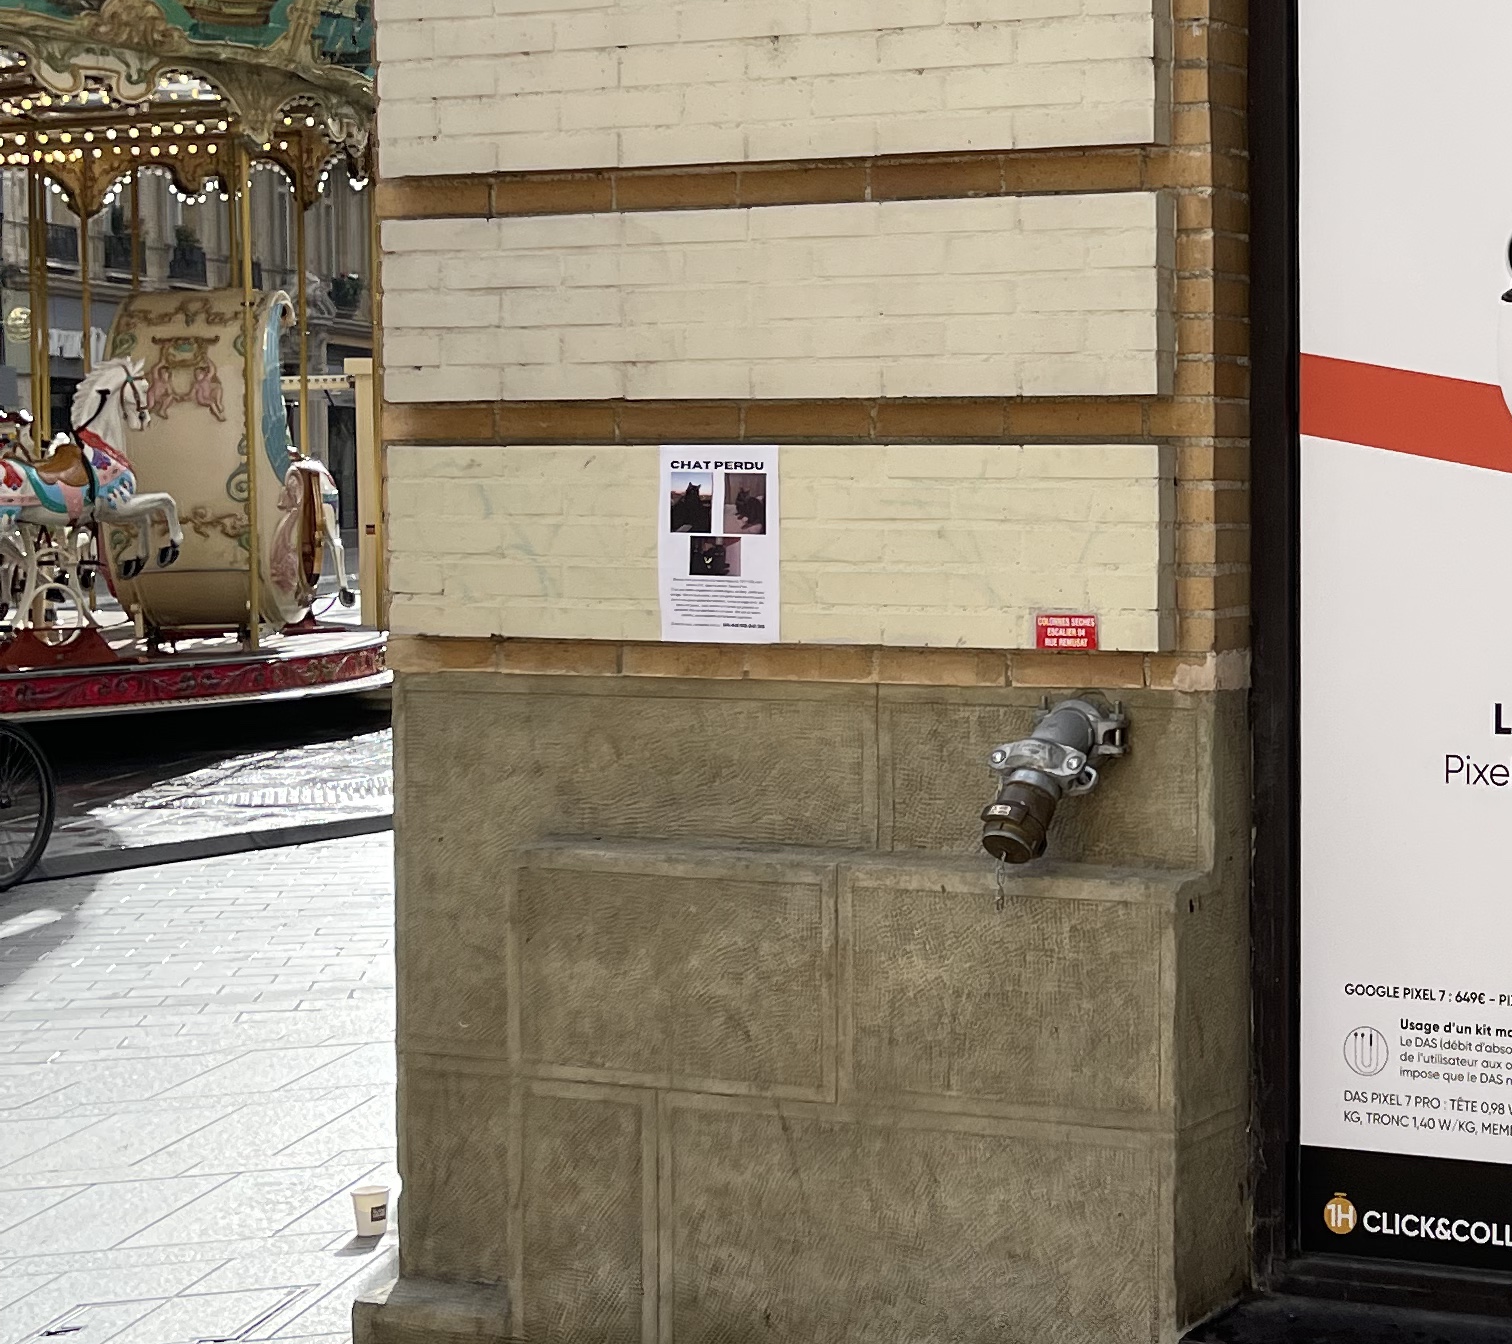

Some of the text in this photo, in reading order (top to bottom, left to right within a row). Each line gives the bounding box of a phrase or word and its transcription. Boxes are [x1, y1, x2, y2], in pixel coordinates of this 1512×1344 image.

[670, 460, 765, 471] CHAT PERDU
[1344, 982, 1400, 999] GOOGLE
[1402, 986, 1437, 1002] PIXEL
[1438, 989, 1446, 1002] 7
[1454, 990, 1486, 1005] 649€
[1399, 1017, 1440, 1035] Usage
[1443, 1021, 1472, 1035] d'un
[1475, 1023, 1492, 1037] kit
[1399, 1035, 1413, 1048] Le
[1414, 1036, 1438, 1049] DAS
[1439, 1037, 1473, 1052] (débit
[1399, 1051, 1415, 1063] de
[1416, 1051, 1479, 1067] l'utilisateur
[1480, 1059, 1503, 1070] aux
[1399, 1065, 1440, 1081] impose
[1442, 1072, 1465, 1084] que
[1466, 1071, 1478, 1083] le
[1479, 1072, 1504, 1085] DAS
[1343, 1089, 1368, 1104] DAS
[1370, 1091, 1403, 1107] PIXEL
[1404, 1094, 1412, 1107] 7
[1414, 1095, 1441, 1110] PRO
[1448, 1096, 1478, 1113] TÊTE
[1480, 1100, 1505, 1116] 0,98
[1343, 1109, 1363, 1126] KG,
[1365, 1111, 1410, 1128] TRONC
[1411, 1115, 1436, 1131] 1,40
[1437, 1118, 1478, 1136] W/KG,
[1327, 1203, 1355, 1229] 1H
